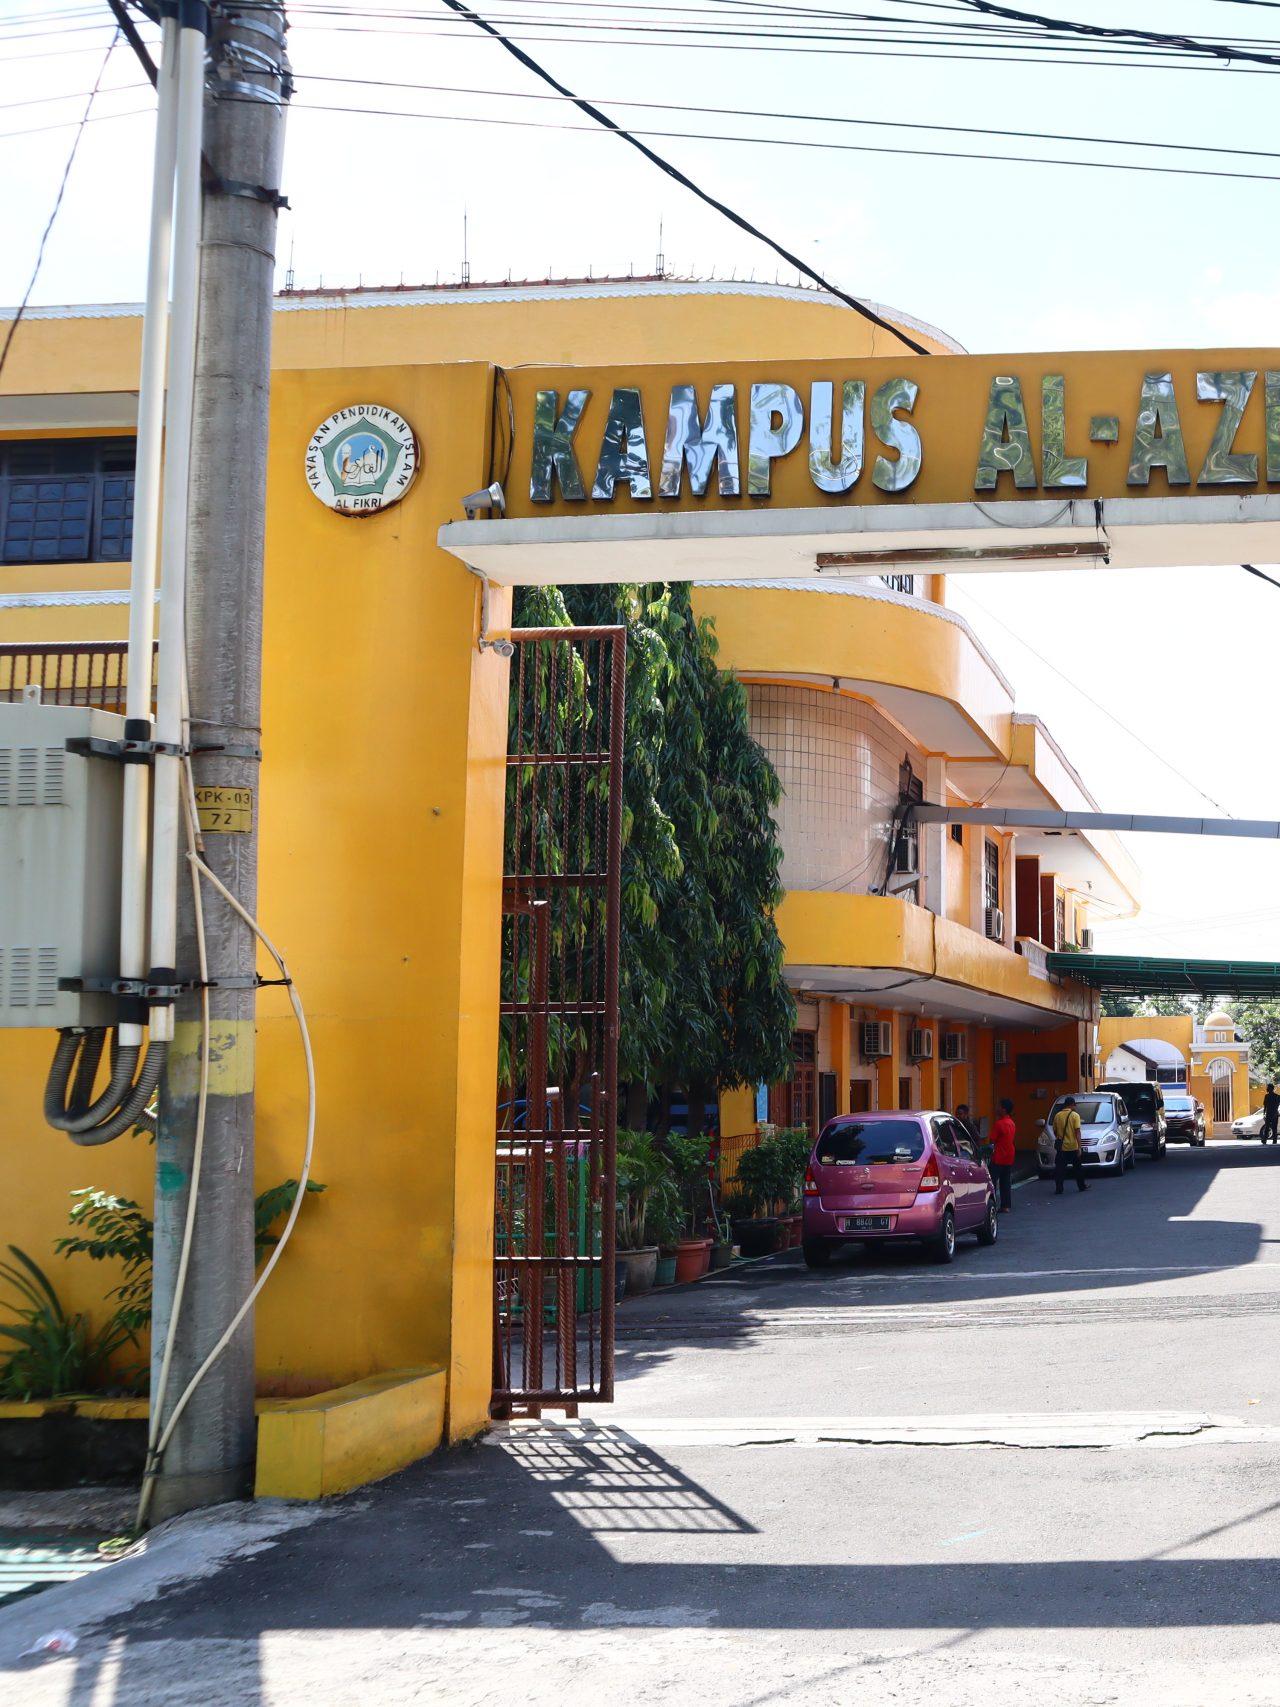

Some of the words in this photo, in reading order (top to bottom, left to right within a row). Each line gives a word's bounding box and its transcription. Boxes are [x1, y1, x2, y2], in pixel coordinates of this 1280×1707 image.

[306, 424, 331, 490] YAYASAN
[332, 406, 407, 433] PENDIDIKAN
[396, 437, 415, 487] ISLAM
[530, 378, 923, 503] KAMPUS
[335, 499, 349, 509] AL
[353, 498, 382, 509] FIKRI
[211, 812, 232, 825] 72
